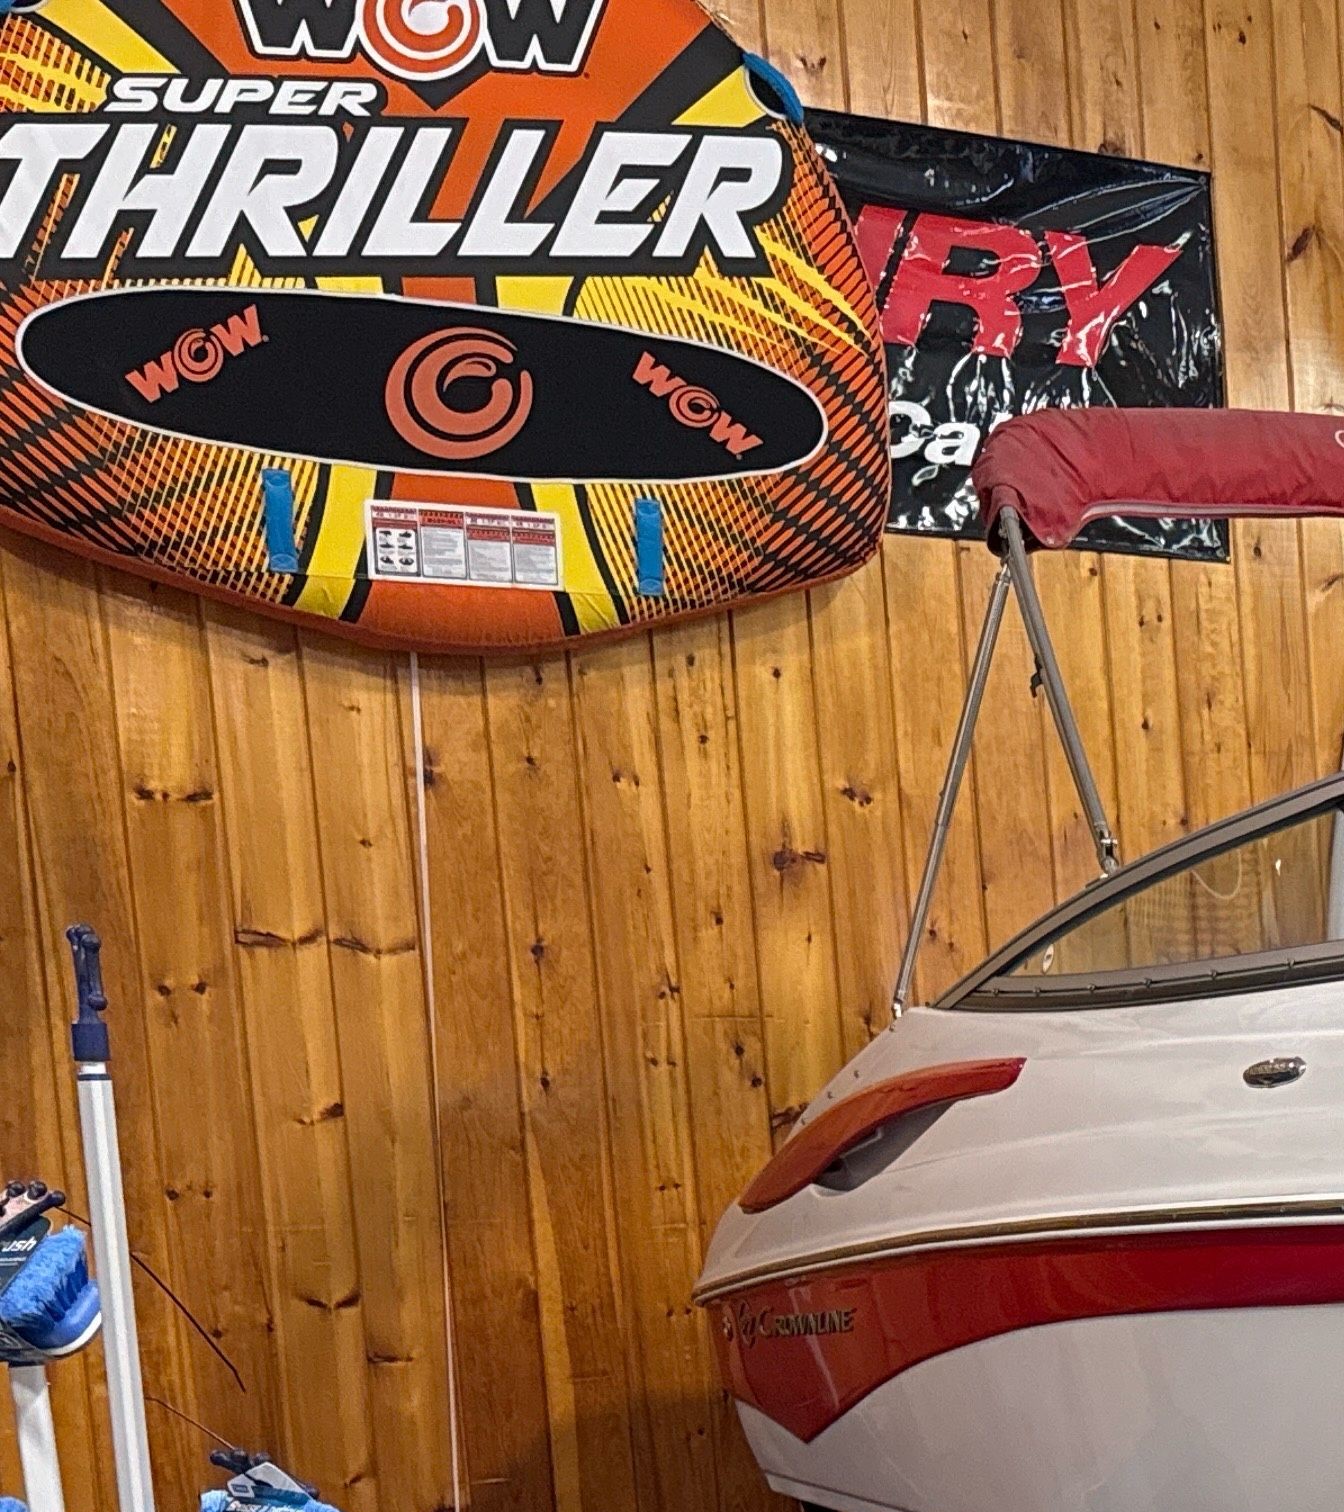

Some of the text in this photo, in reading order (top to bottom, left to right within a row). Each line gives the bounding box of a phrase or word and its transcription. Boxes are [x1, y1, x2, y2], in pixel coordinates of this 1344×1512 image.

[103, 76, 379, 117] SUPER
[0, 123, 784, 260] THRILLER
[125, 304, 264, 403] WOW
[632, 351, 763, 455] WOW
